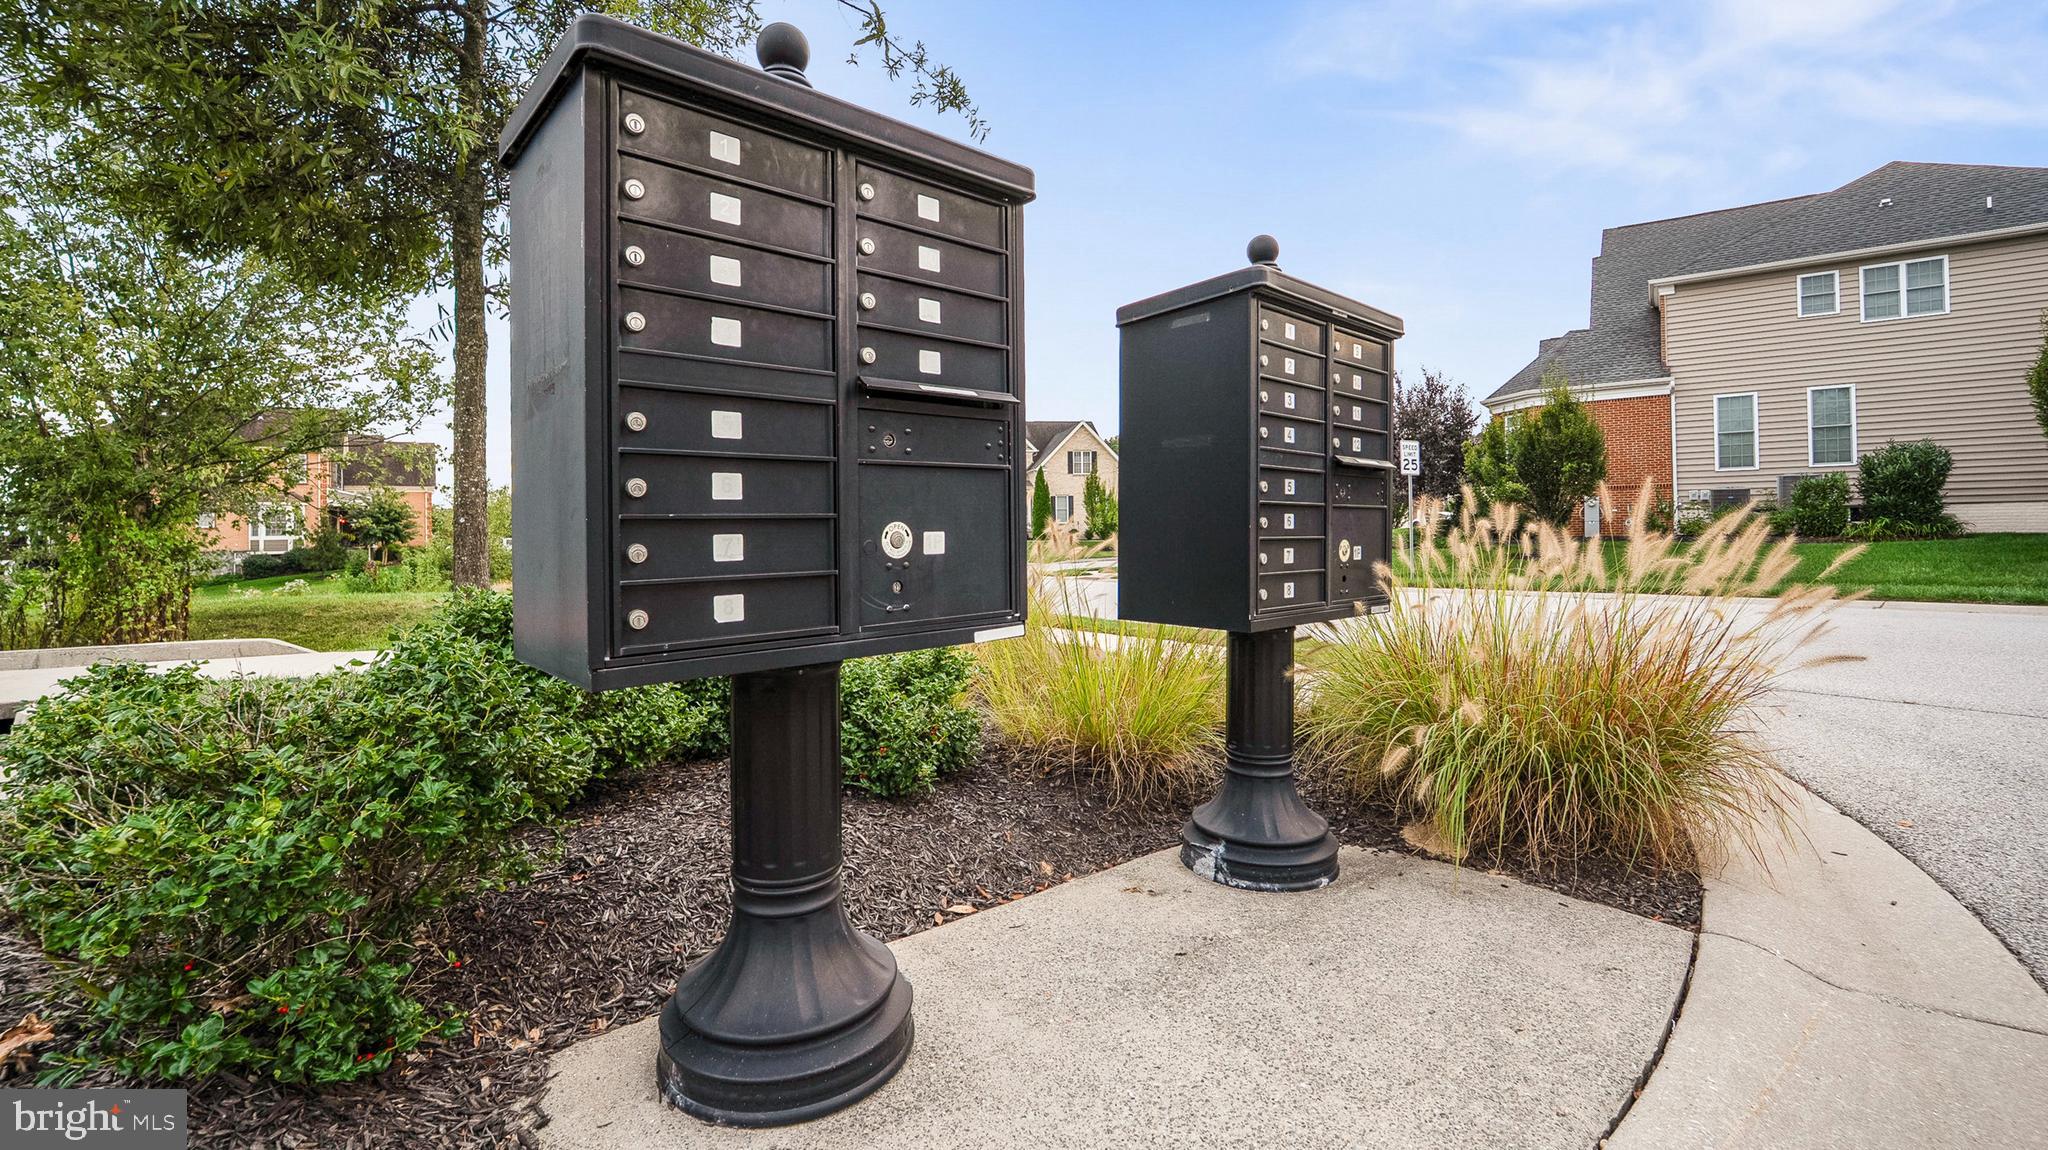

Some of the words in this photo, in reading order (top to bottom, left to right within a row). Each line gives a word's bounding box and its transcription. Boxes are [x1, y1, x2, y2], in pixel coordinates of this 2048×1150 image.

[720, 138, 728, 157] 1
[719, 199, 730, 217] 2
[1287, 394, 1293, 407] 3
[1353, 439, 1361, 450] 12
[1403, 458, 1418, 471] 25
[888, 523, 906, 532] OPEN
[722, 598, 734, 616] 8
